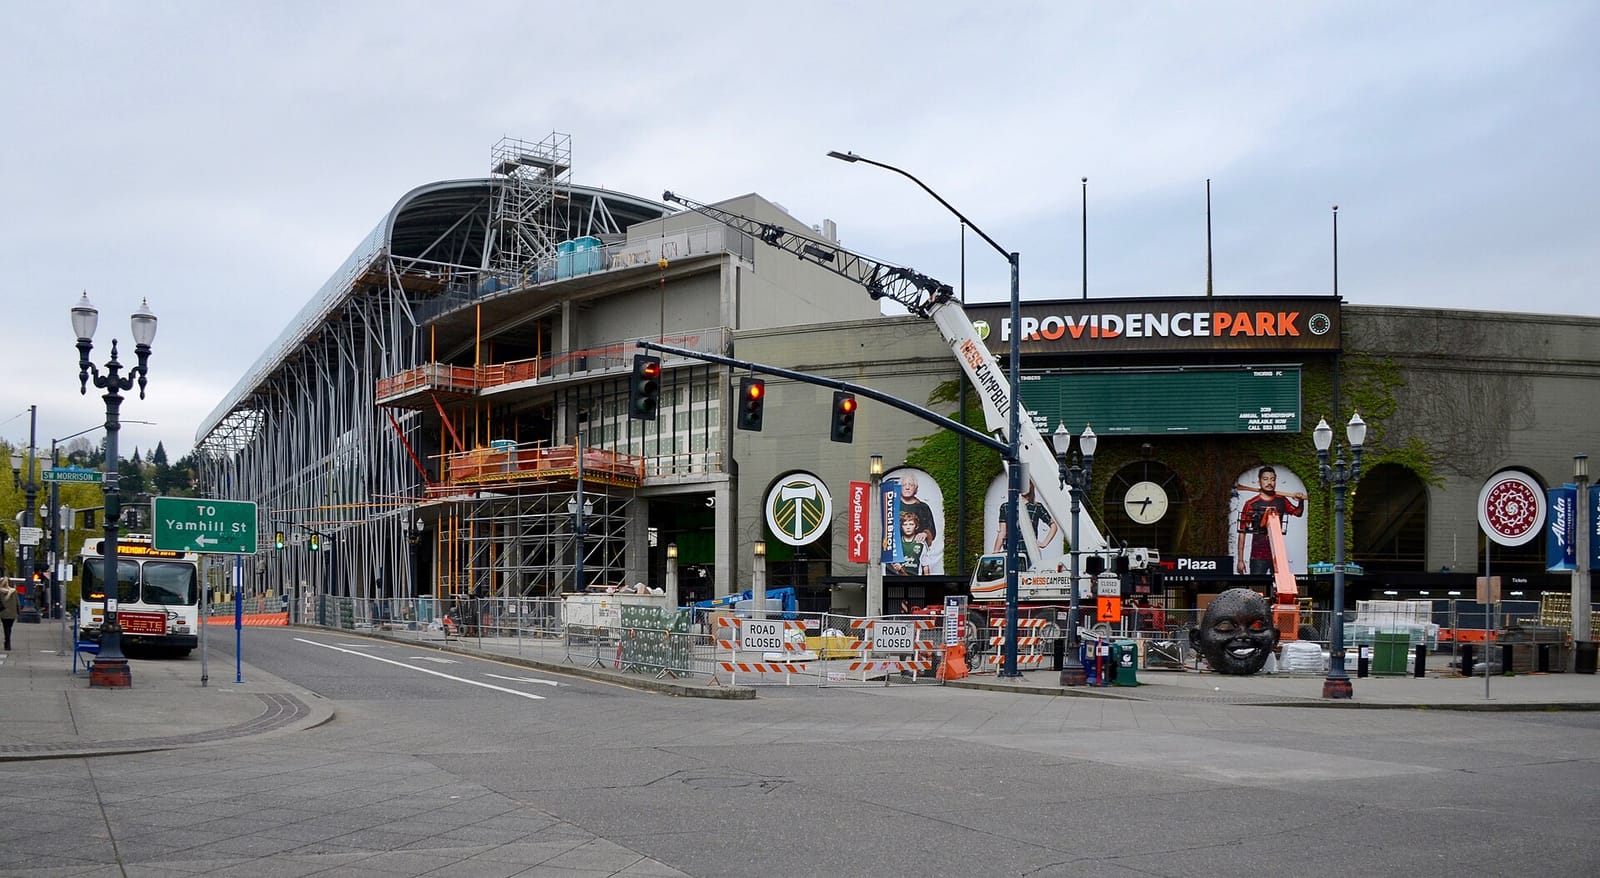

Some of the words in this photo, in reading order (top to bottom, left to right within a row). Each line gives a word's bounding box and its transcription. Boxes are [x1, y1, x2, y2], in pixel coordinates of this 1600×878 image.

[1212, 311, 1300, 336] PARK
[56, 473, 93, 481] MORRISON
[1490, 482, 1534, 503] PORTLAND
[197, 505, 216, 516] TO
[853, 486, 864, 532] KeyBank
[166, 519, 224, 531] Yamhill
[231, 522, 247, 532] St
[1490, 516, 1534, 534] THORNS
[1551, 497, 1565, 546] Alaska
[1177, 558, 1216, 569] Plaza
[1046, 577, 1071, 585] CAMPBEL
[750, 624, 775, 635] ROAD
[882, 626, 907, 636] ROAD
[744, 637, 781, 648] CLOSED
[876, 638, 911, 648] CLOSED
